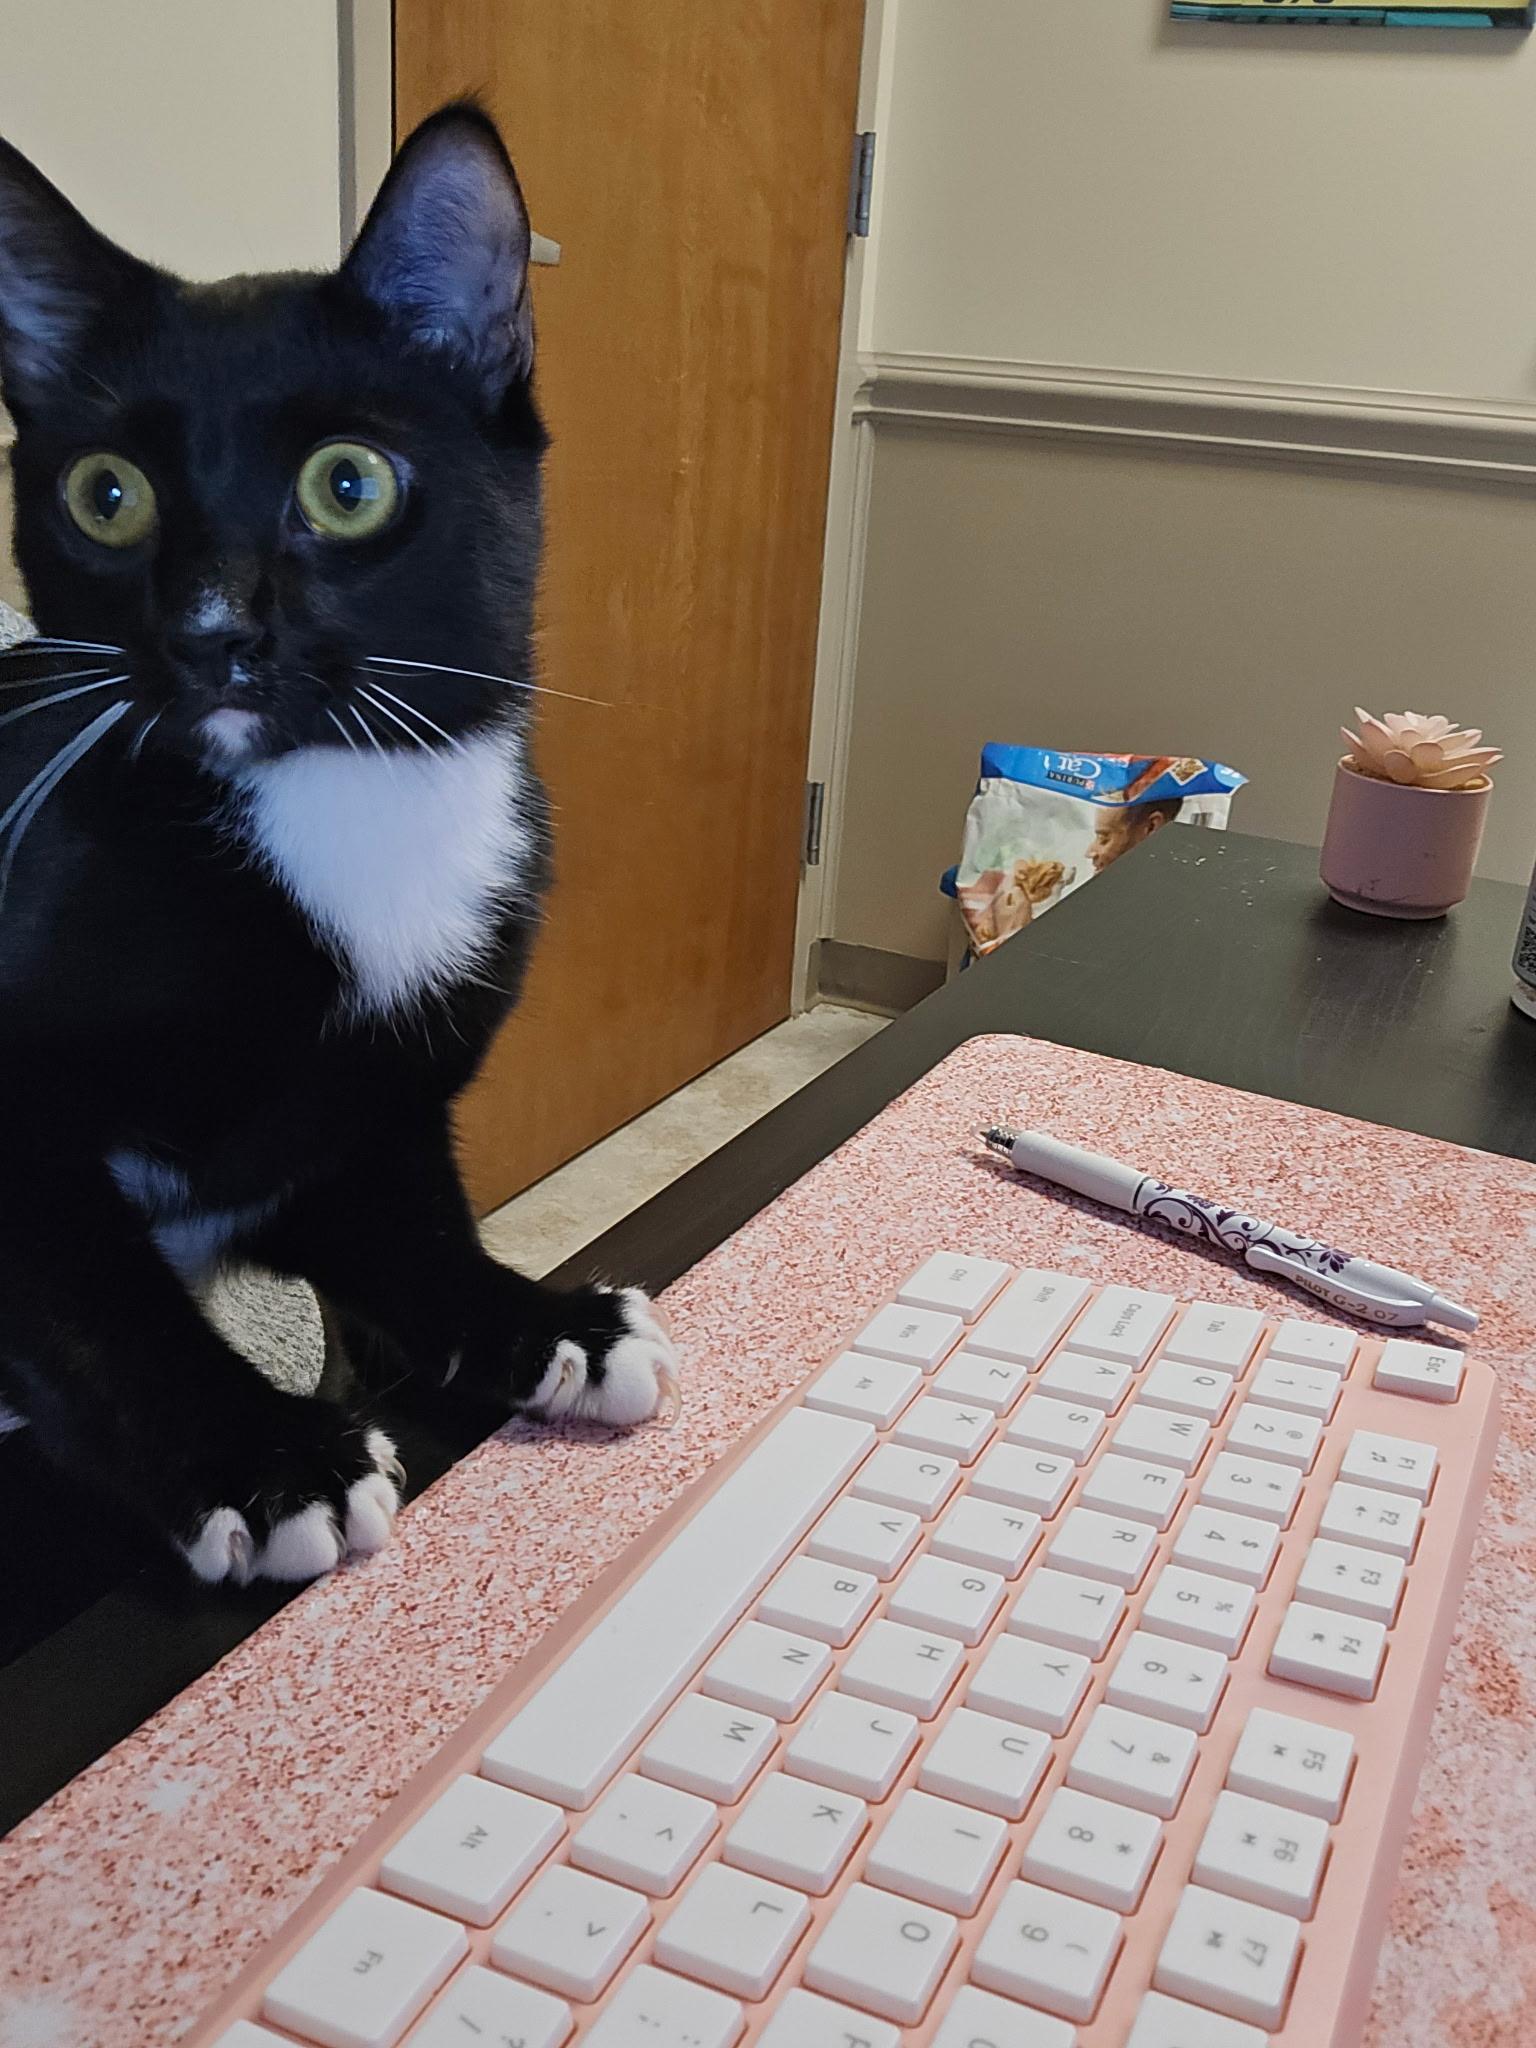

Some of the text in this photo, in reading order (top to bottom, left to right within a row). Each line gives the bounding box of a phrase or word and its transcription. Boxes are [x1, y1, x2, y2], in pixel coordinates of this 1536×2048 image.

[948, 1268, 969, 1282] Ctrl
[1295, 1274, 1330, 1297] PILOT
[1333, 1294, 1368, 1314] G-2
[1109, 1303, 1143, 1338] Caps Lock
[1206, 1320, 1226, 1333] Tab
[898, 1324, 920, 1339] Win
[1095, 1366, 1116, 1377] A
[1425, 1356, 1447, 1374] Esc
[989, 1367, 1010, 1380] Z
[855, 1376, 874, 1390] Alt
[1192, 1376, 1217, 1387] Q
[955, 1412, 980, 1425] X
[1067, 1412, 1089, 1424] S
[1169, 1422, 1194, 1437] W
[1253, 1422, 1275, 1433] 2
[918, 1463, 941, 1476] C
[1035, 1461, 1058, 1474] D
[1397, 1456, 1417, 1471] F1
[1142, 1473, 1168, 1485] E
[1230, 1473, 1253, 1485] 3
[1002, 1517, 1024, 1531] F
[1378, 1509, 1401, 1526] F2
[879, 1521, 903, 1533] V
[1111, 1529, 1138, 1543] R
[1203, 1530, 1226, 1542] 4
[1359, 1568, 1382, 1586] F3
[833, 1579, 859, 1594] B
[960, 1578, 986, 1593] G
[1079, 1593, 1105, 1606] T
[1175, 1590, 1201, 1604] 5
[1338, 1635, 1362, 1655] F4
[781, 1647, 811, 1665] N
[915, 1644, 945, 1662] H
[1042, 1662, 1070, 1677] Y
[1142, 1660, 1169, 1675] 6
[722, 1721, 755, 1743] M
[1000, 1736, 1030, 1756] U
[1110, 1739, 1136, 1755] 7
[1301, 1748, 1327, 1773] F5
[812, 1804, 843, 1824] K
[460, 1824, 489, 1850] Alt
[1067, 1825, 1095, 1844] 8
[1272, 1837, 1300, 1864] F6
[751, 1900, 784, 1914] L
[899, 1920, 931, 1943] O
[1020, 1923, 1050, 1944] 9
[1241, 1937, 1269, 1968] F7
[352, 1949, 384, 1975] Fn
